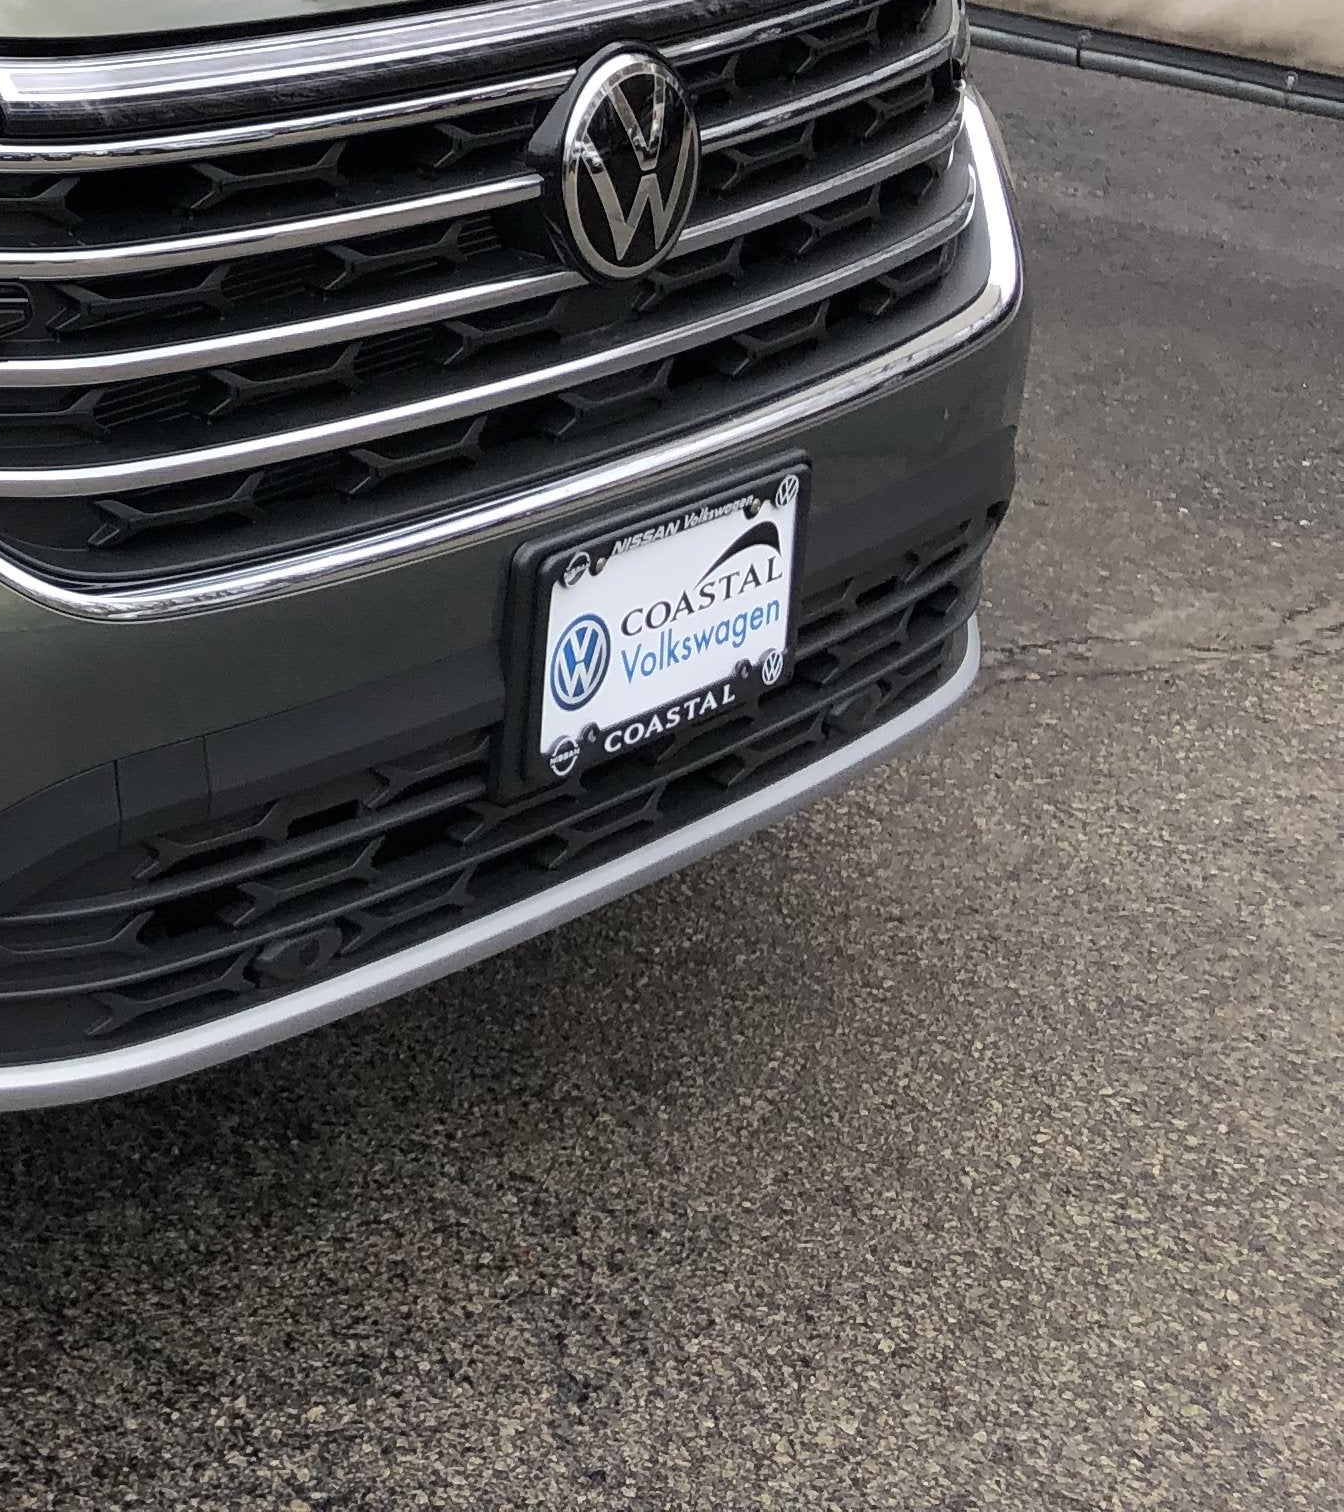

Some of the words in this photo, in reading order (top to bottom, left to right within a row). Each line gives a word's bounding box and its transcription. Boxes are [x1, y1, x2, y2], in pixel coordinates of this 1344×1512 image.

[611, 519, 681, 557] NISSAN
[684, 494, 754, 529] Volkswagen
[620, 557, 784, 637] COASTAL
[621, 598, 780, 684] Volkswagen
[603, 684, 736, 754] COASTAL
